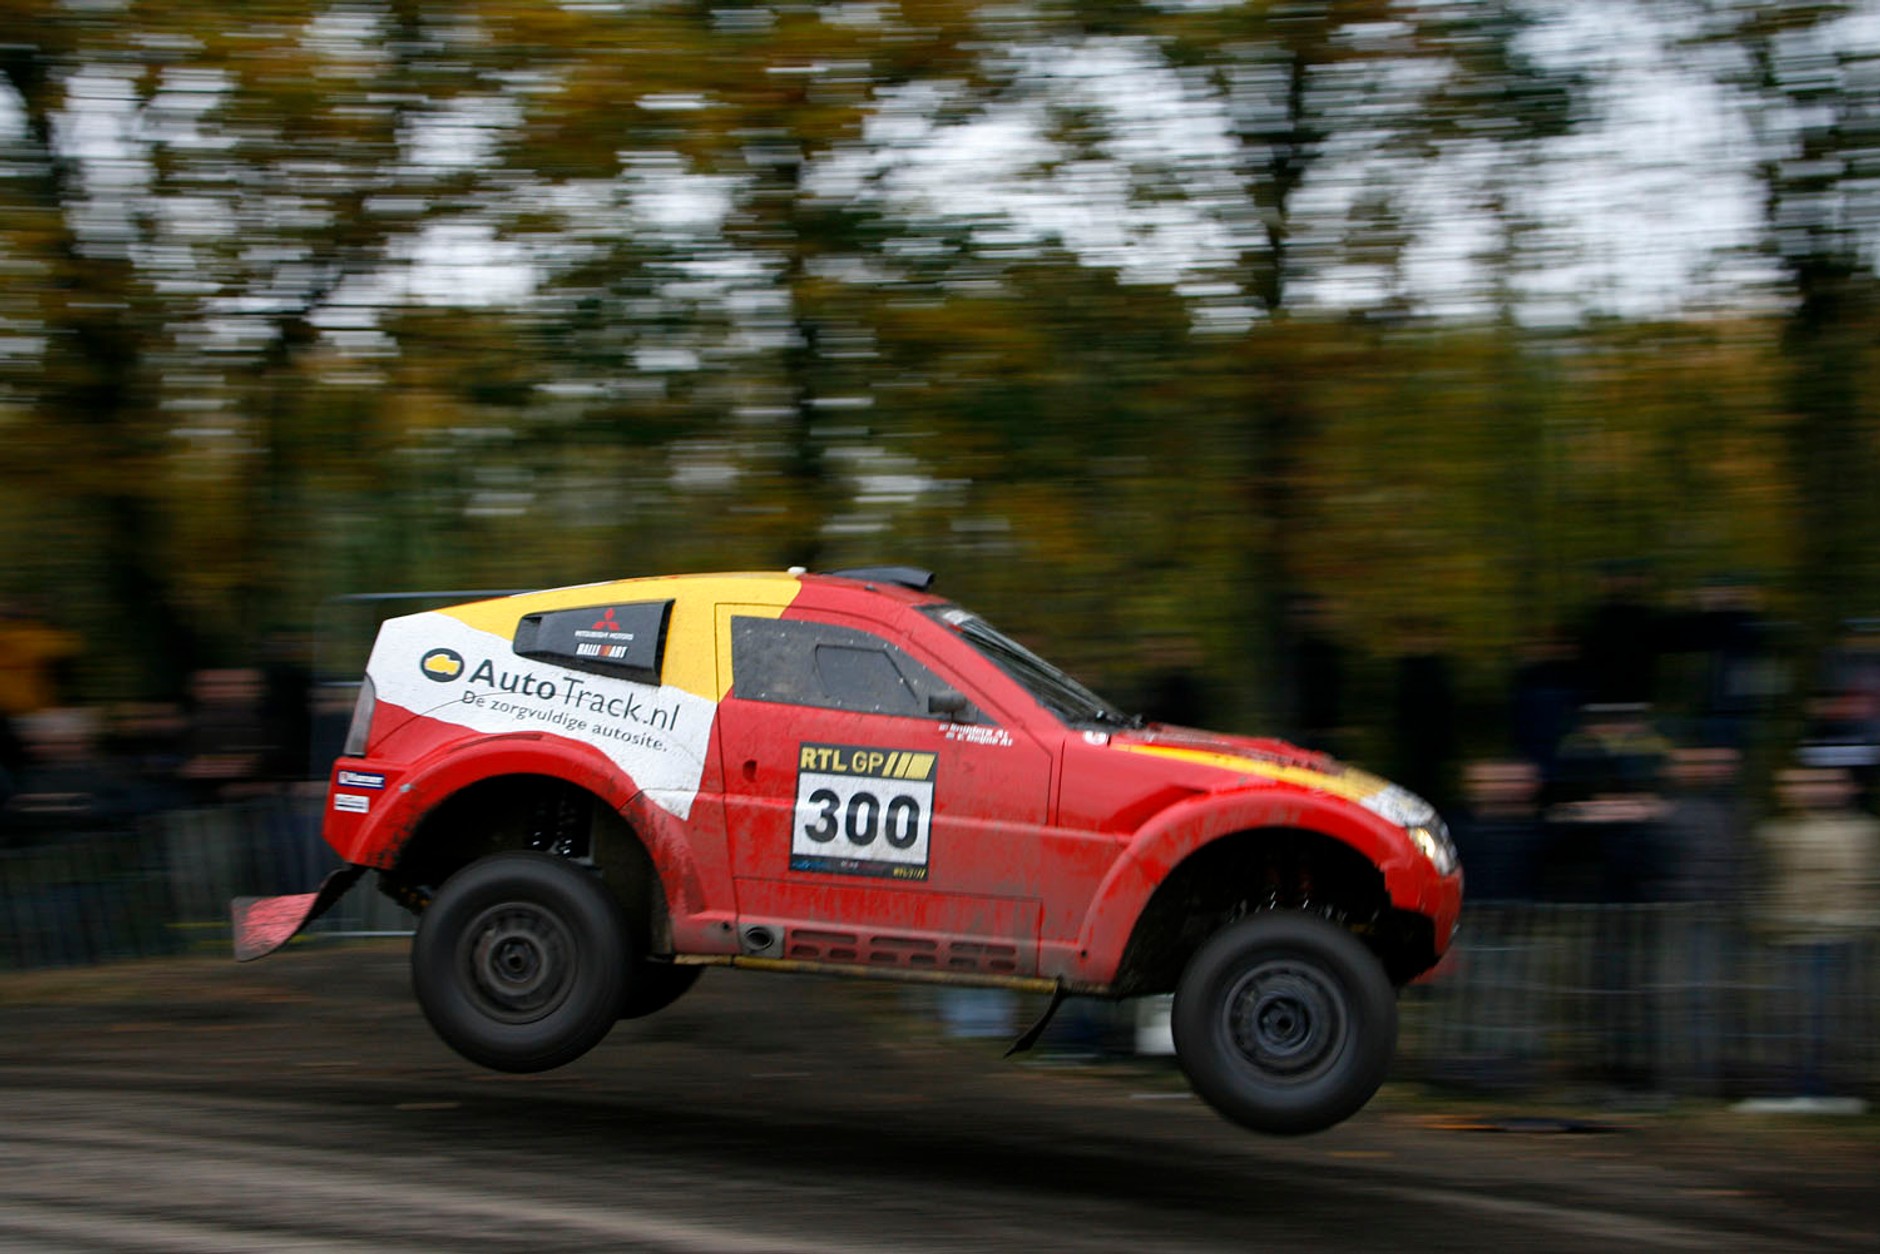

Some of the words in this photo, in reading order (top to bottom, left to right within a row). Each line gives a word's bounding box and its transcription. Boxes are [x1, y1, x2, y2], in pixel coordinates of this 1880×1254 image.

[461, 690, 486, 708] De
[490, 700, 587, 731] zorgvuldige
[592, 724, 668, 752] autosite.
[468, 659, 680, 731] AutoTrack.nl
[801, 747, 848, 771] RTL
[852, 751, 884, 775] GP
[804, 788, 920, 850] 300
